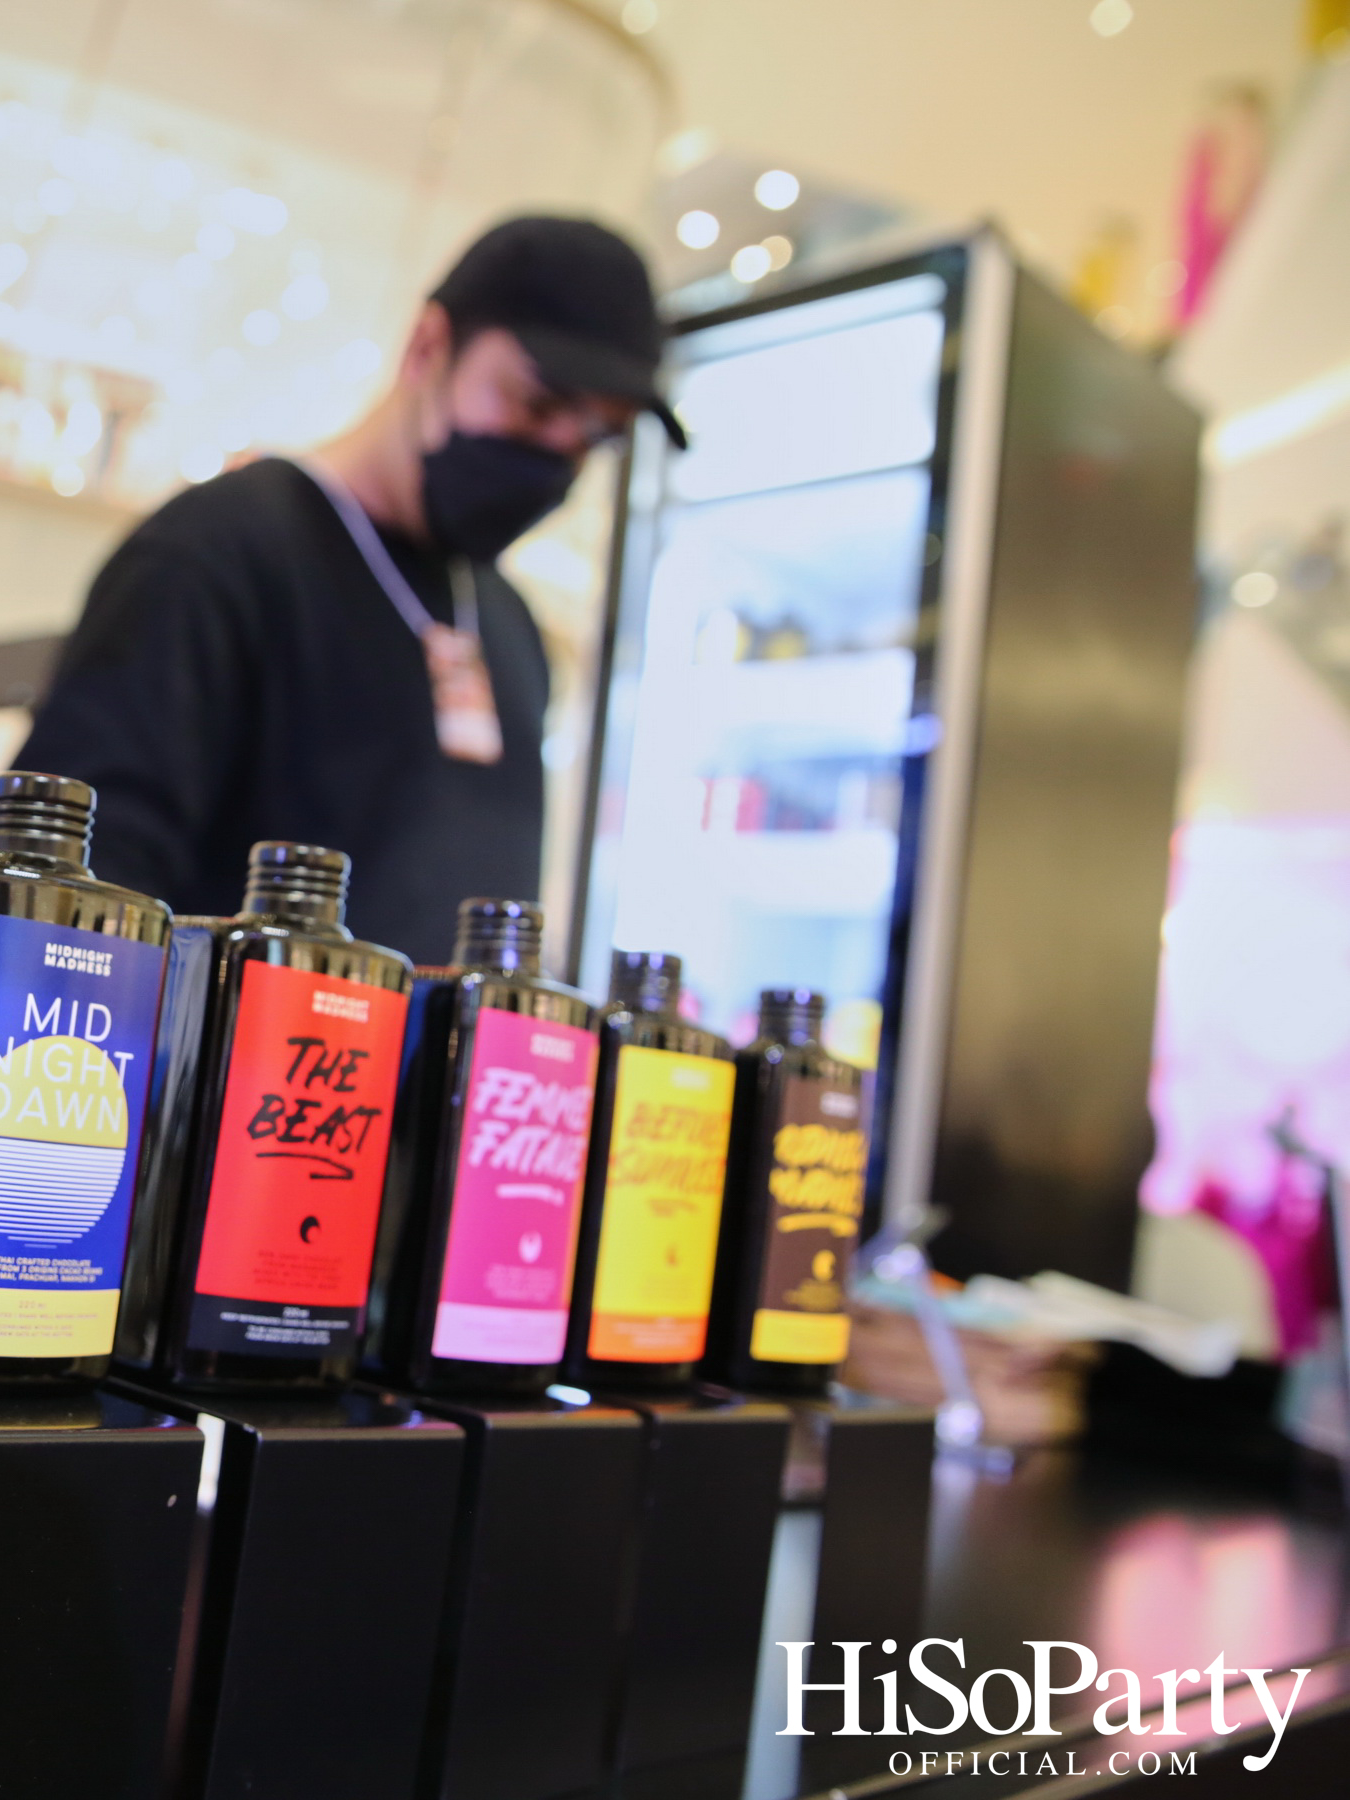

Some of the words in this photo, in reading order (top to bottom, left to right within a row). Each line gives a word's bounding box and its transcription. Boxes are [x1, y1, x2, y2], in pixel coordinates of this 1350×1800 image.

[44, 954, 111, 977] MADNESS
[45, 942, 113, 964] MIDNIGHT
[23, 992, 112, 1043] MID
[287, 1037, 370, 1093] THE
[247, 1094, 382, 1154] BEAST
